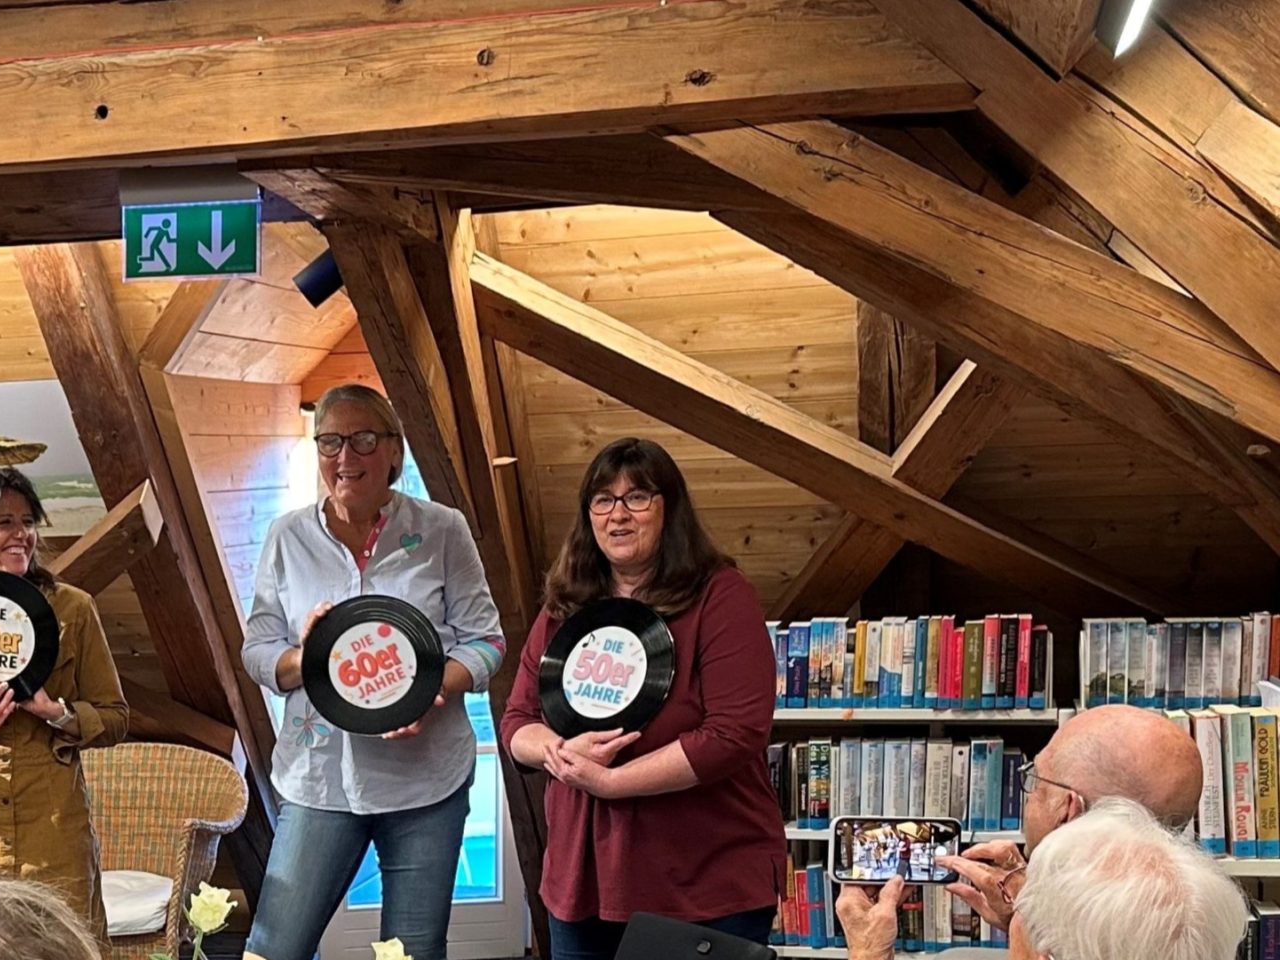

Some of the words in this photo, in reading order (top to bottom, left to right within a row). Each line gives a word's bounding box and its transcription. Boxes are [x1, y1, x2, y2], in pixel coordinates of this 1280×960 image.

[350, 634, 374, 654] DIE
[602, 637, 625, 655] DIE
[338, 641, 402, 688] 60er
[574, 650, 635, 687] 50er
[358, 666, 407, 700] JAHRE
[573, 681, 624, 706] JAHRE
[1258, 728, 1269, 755] GOLD
[1236, 805, 1251, 840] ROUG
